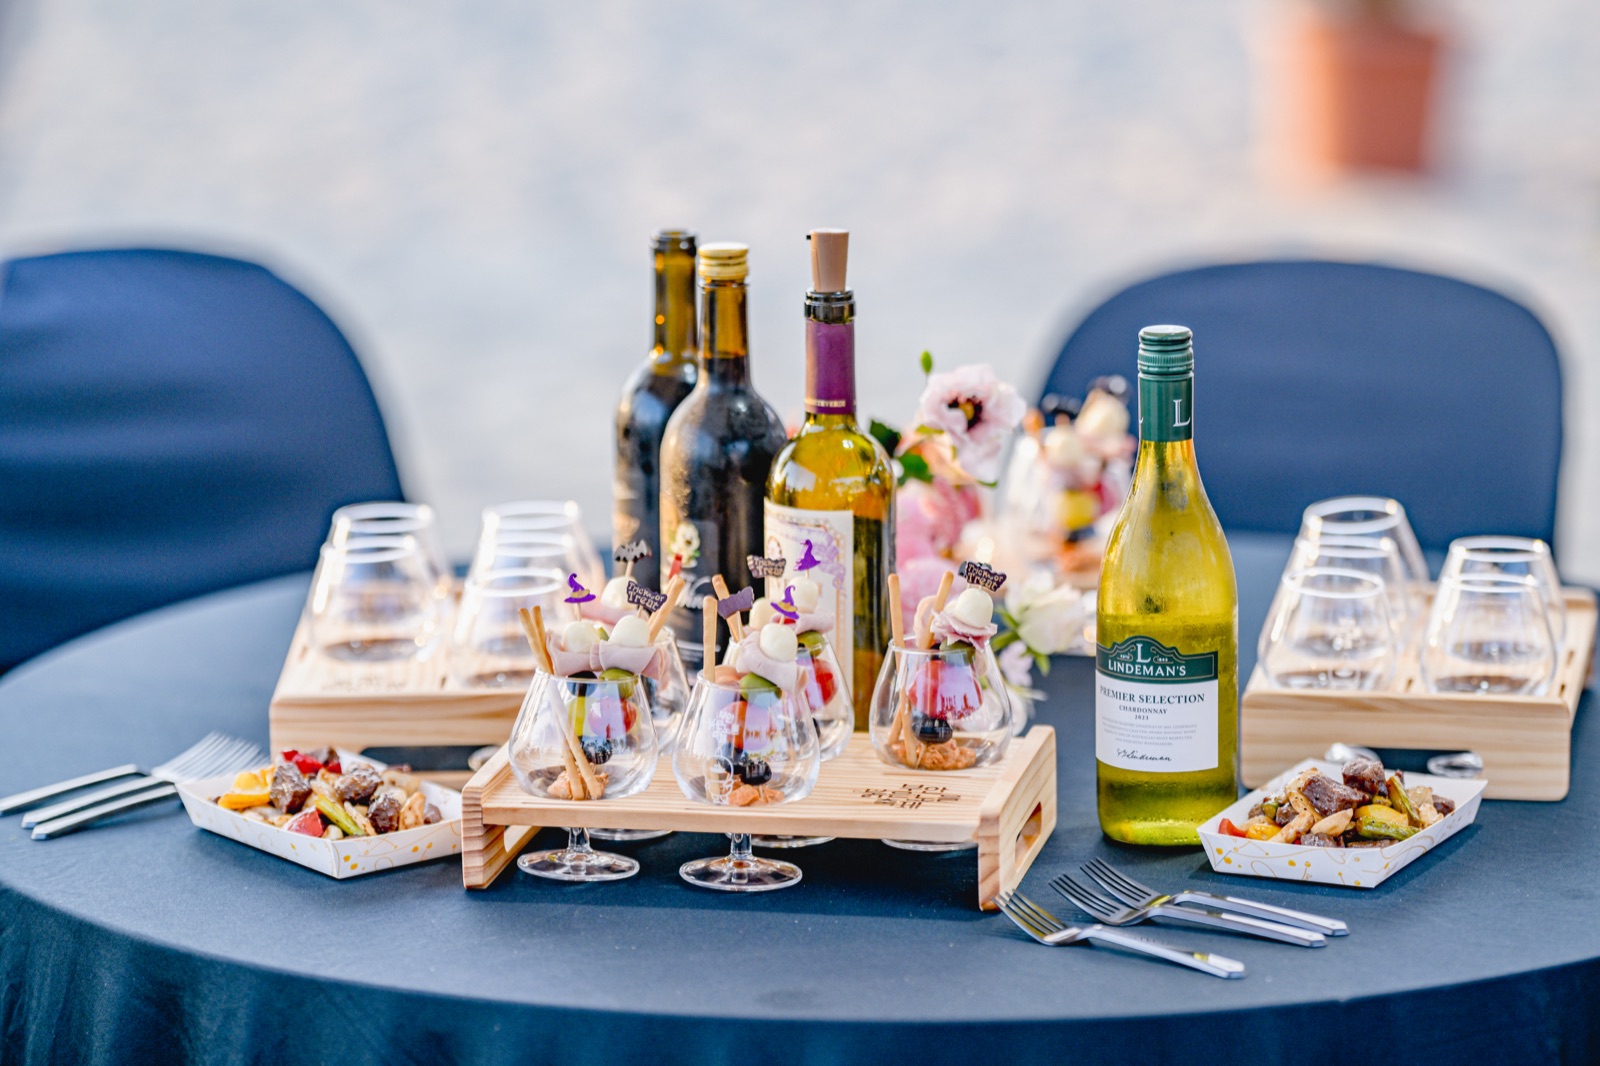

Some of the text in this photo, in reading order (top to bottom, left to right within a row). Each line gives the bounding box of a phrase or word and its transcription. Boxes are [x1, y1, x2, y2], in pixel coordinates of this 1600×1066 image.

[1172, 398, 1191, 428] L
[967, 571, 998, 590] Treat
[628, 590, 659, 611] Treat
[1136, 643, 1152, 663] L
[1108, 659, 1187, 677] LINDEMAN'S
[1099, 685, 1206, 704] PREMIER SELECTION
[1118, 704, 1168, 715] CHARDONNAY
